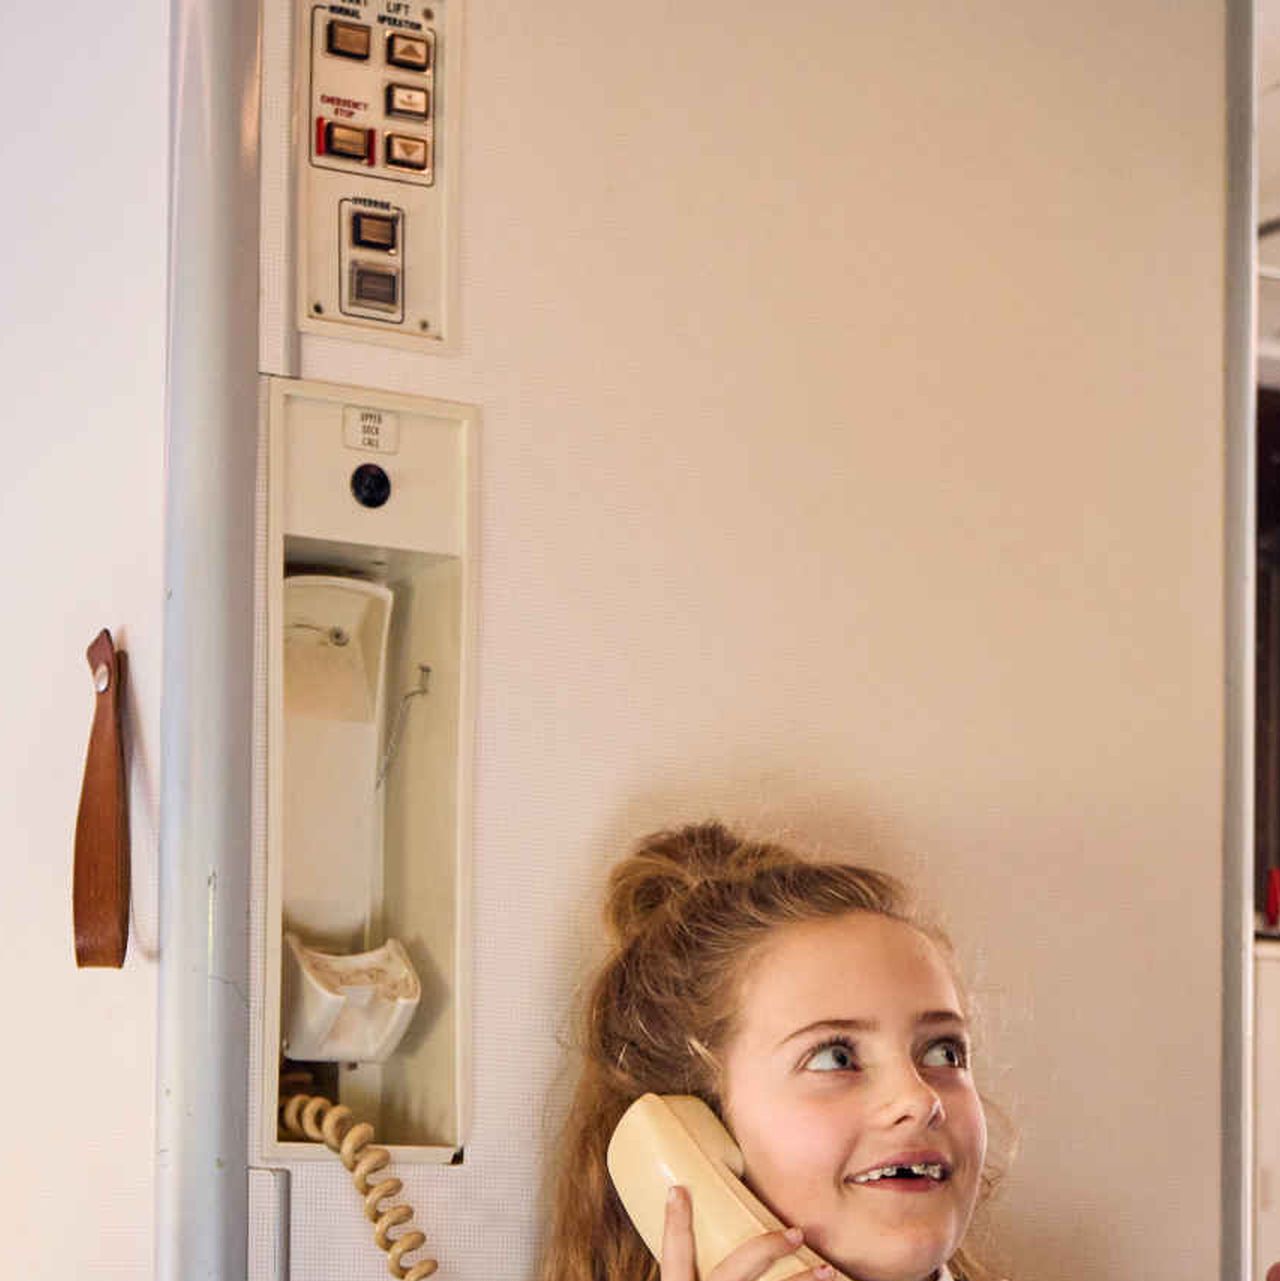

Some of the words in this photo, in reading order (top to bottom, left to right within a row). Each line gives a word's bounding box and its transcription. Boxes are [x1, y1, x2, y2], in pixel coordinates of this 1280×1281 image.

[385, 2, 411, 17] LIFT
[377, 14, 422, 31] OPERATION
[320, 94, 368, 112] EMERGENCY
